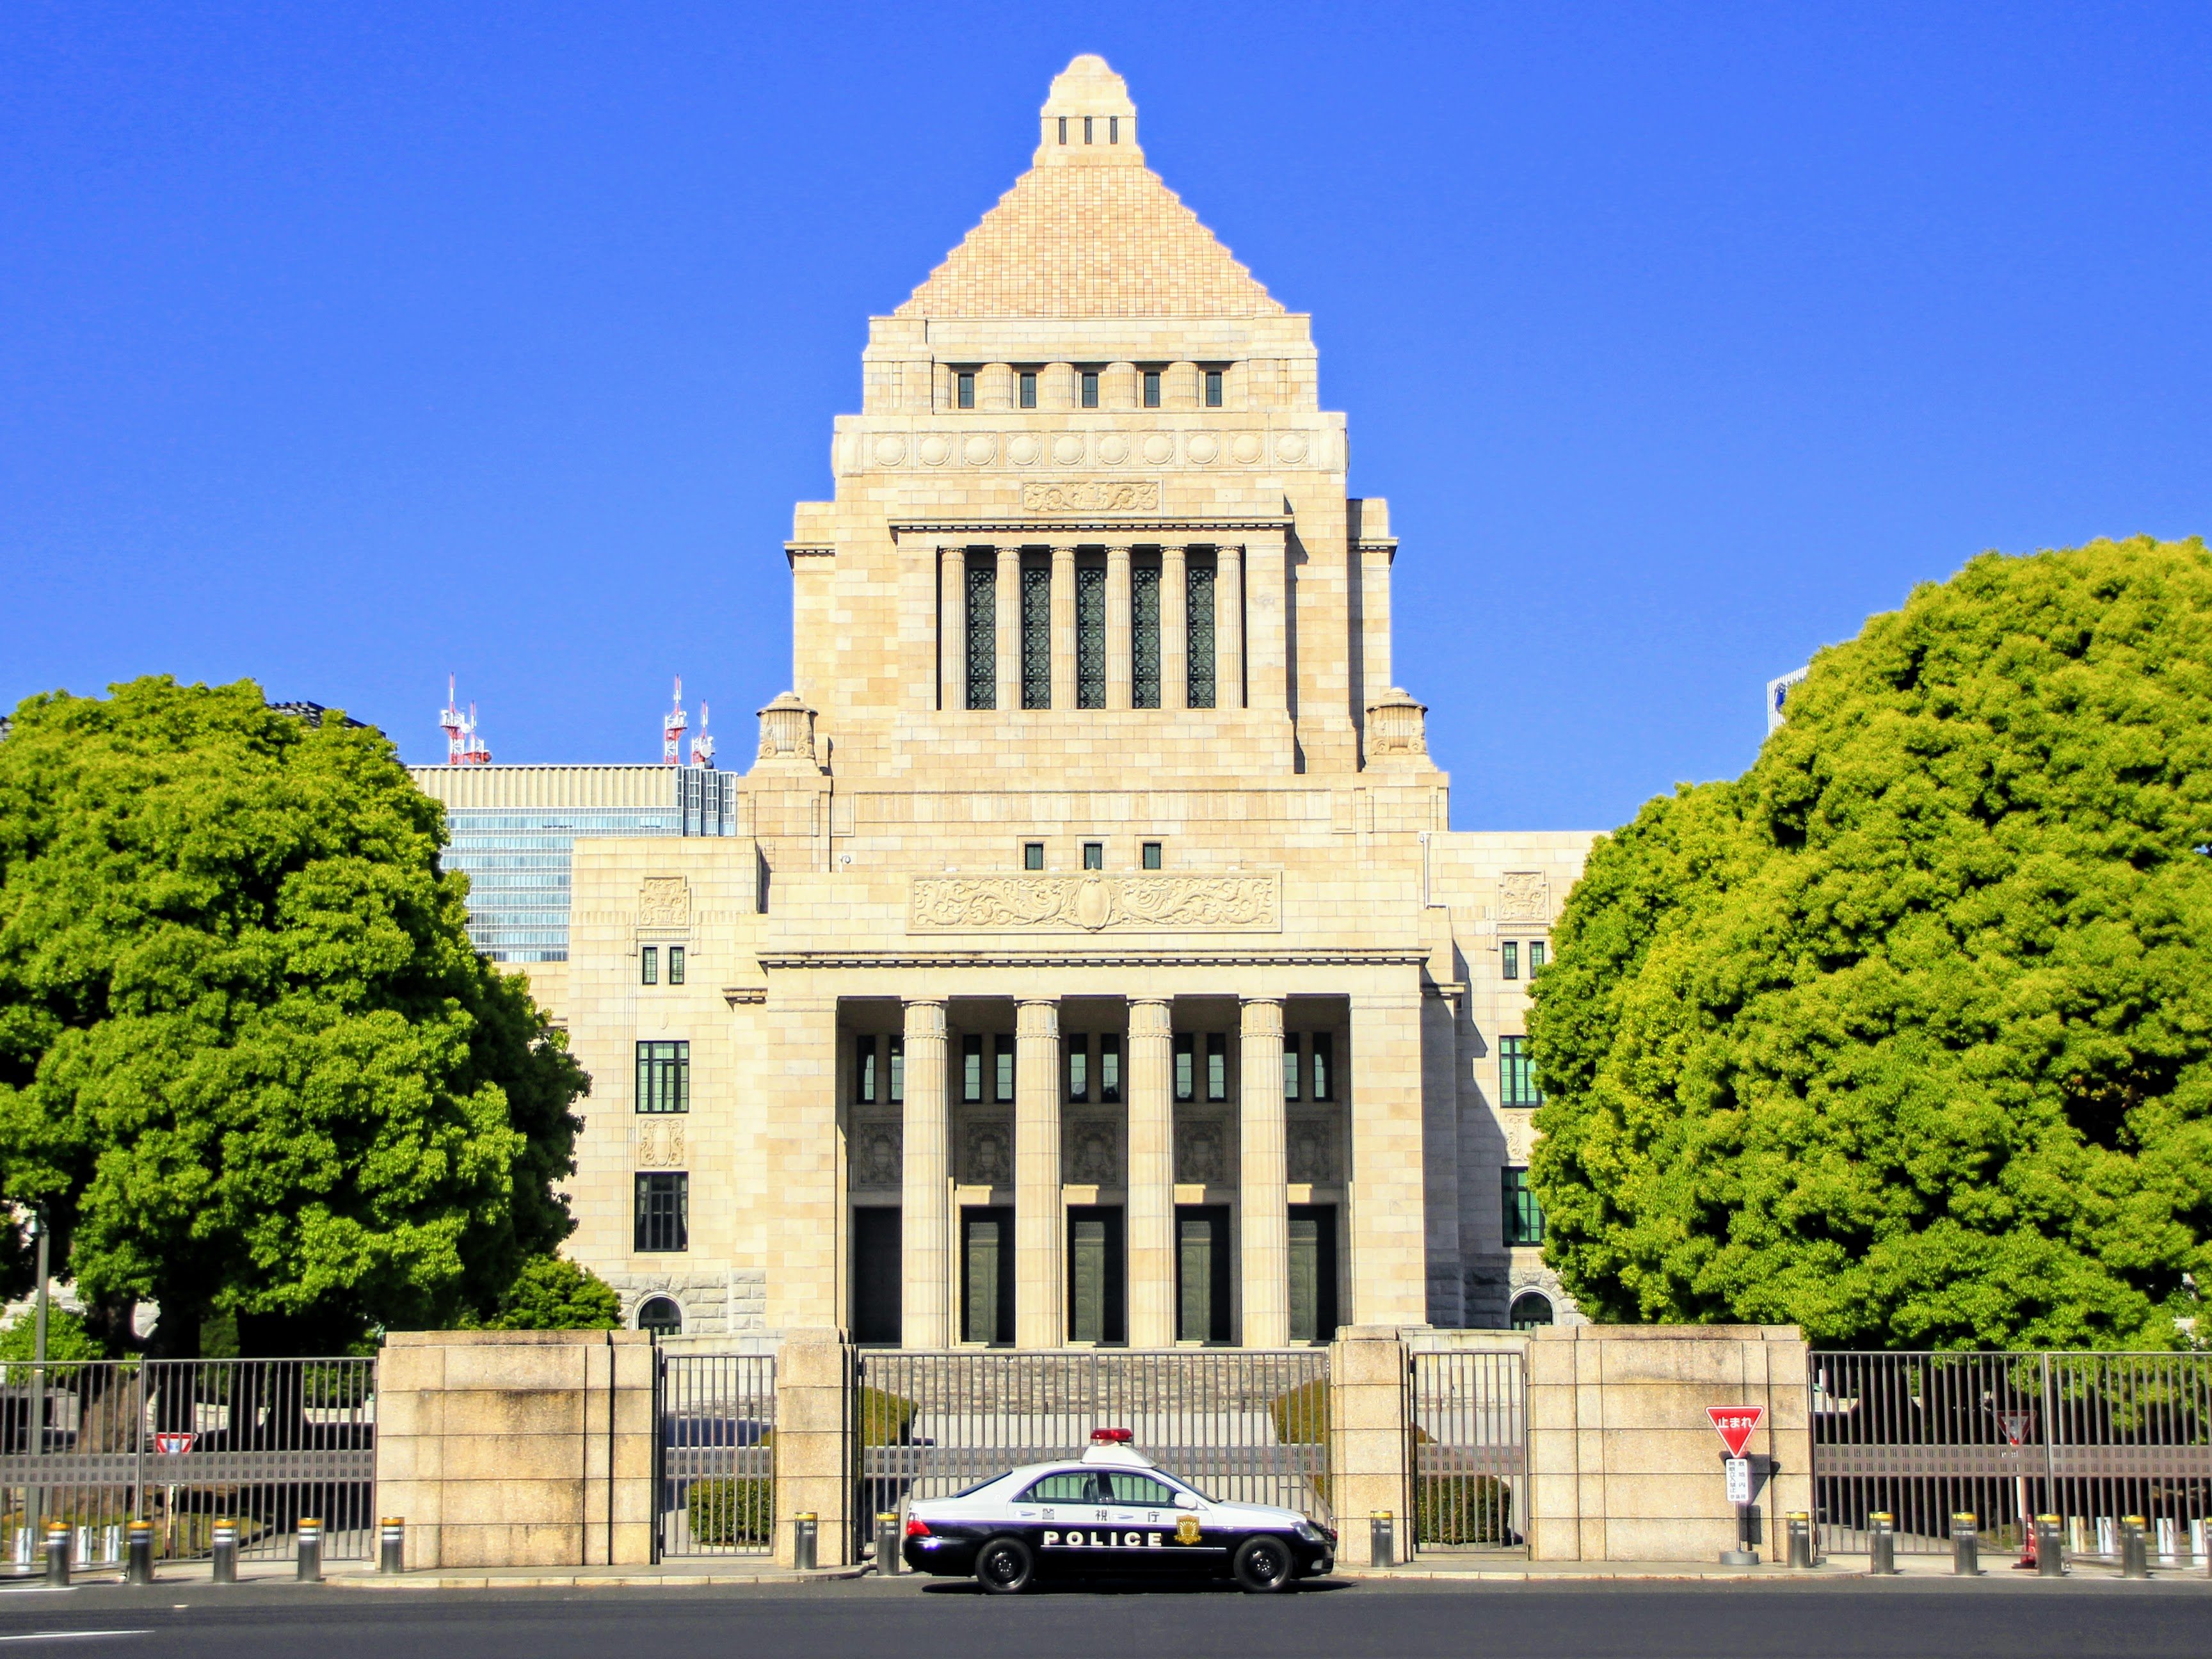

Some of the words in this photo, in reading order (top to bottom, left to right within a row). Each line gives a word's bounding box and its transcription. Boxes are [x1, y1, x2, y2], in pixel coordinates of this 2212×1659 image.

[1717, 1416, 1752, 1429] 止まれ
[1042, 1507, 1160, 1523] 警視庁
[1043, 1530, 1162, 1547] POLICE
